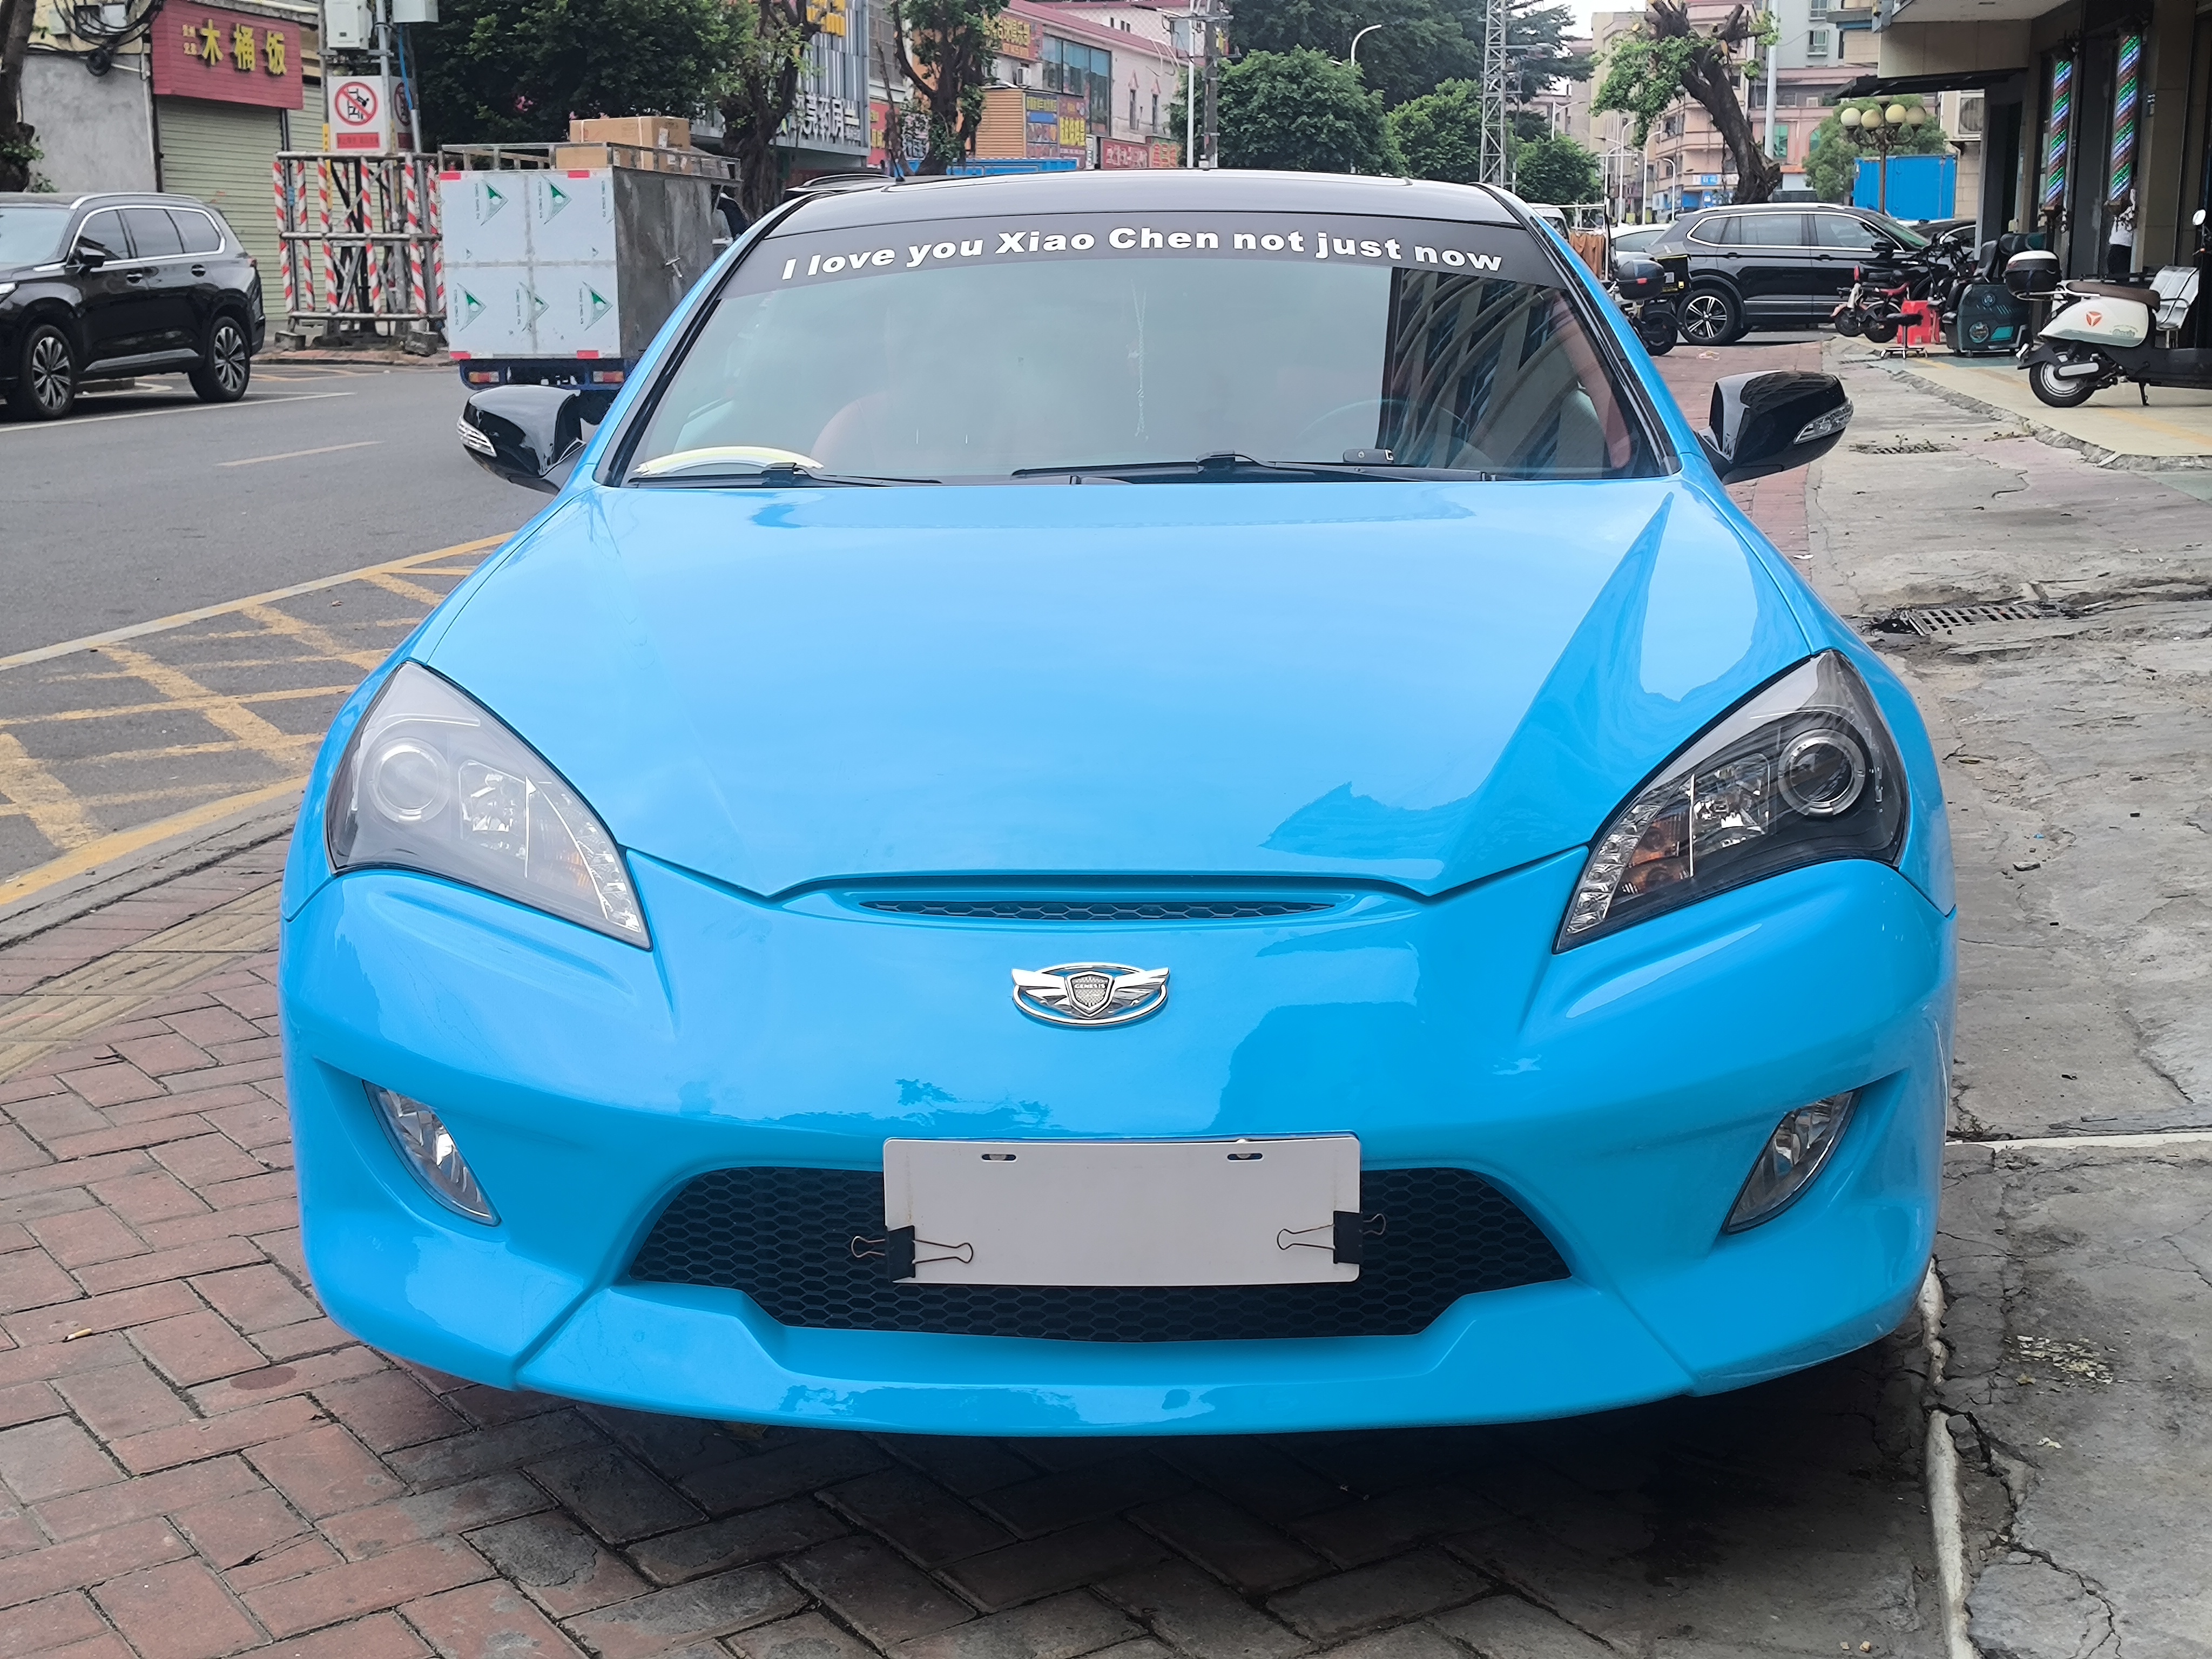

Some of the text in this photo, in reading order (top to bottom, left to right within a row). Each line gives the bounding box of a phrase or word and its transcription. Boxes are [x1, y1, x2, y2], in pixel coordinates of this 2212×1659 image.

[200, 18, 287, 75] 木桶饭
[782, 227, 1501, 280] I love you Xiao Chen not just now
